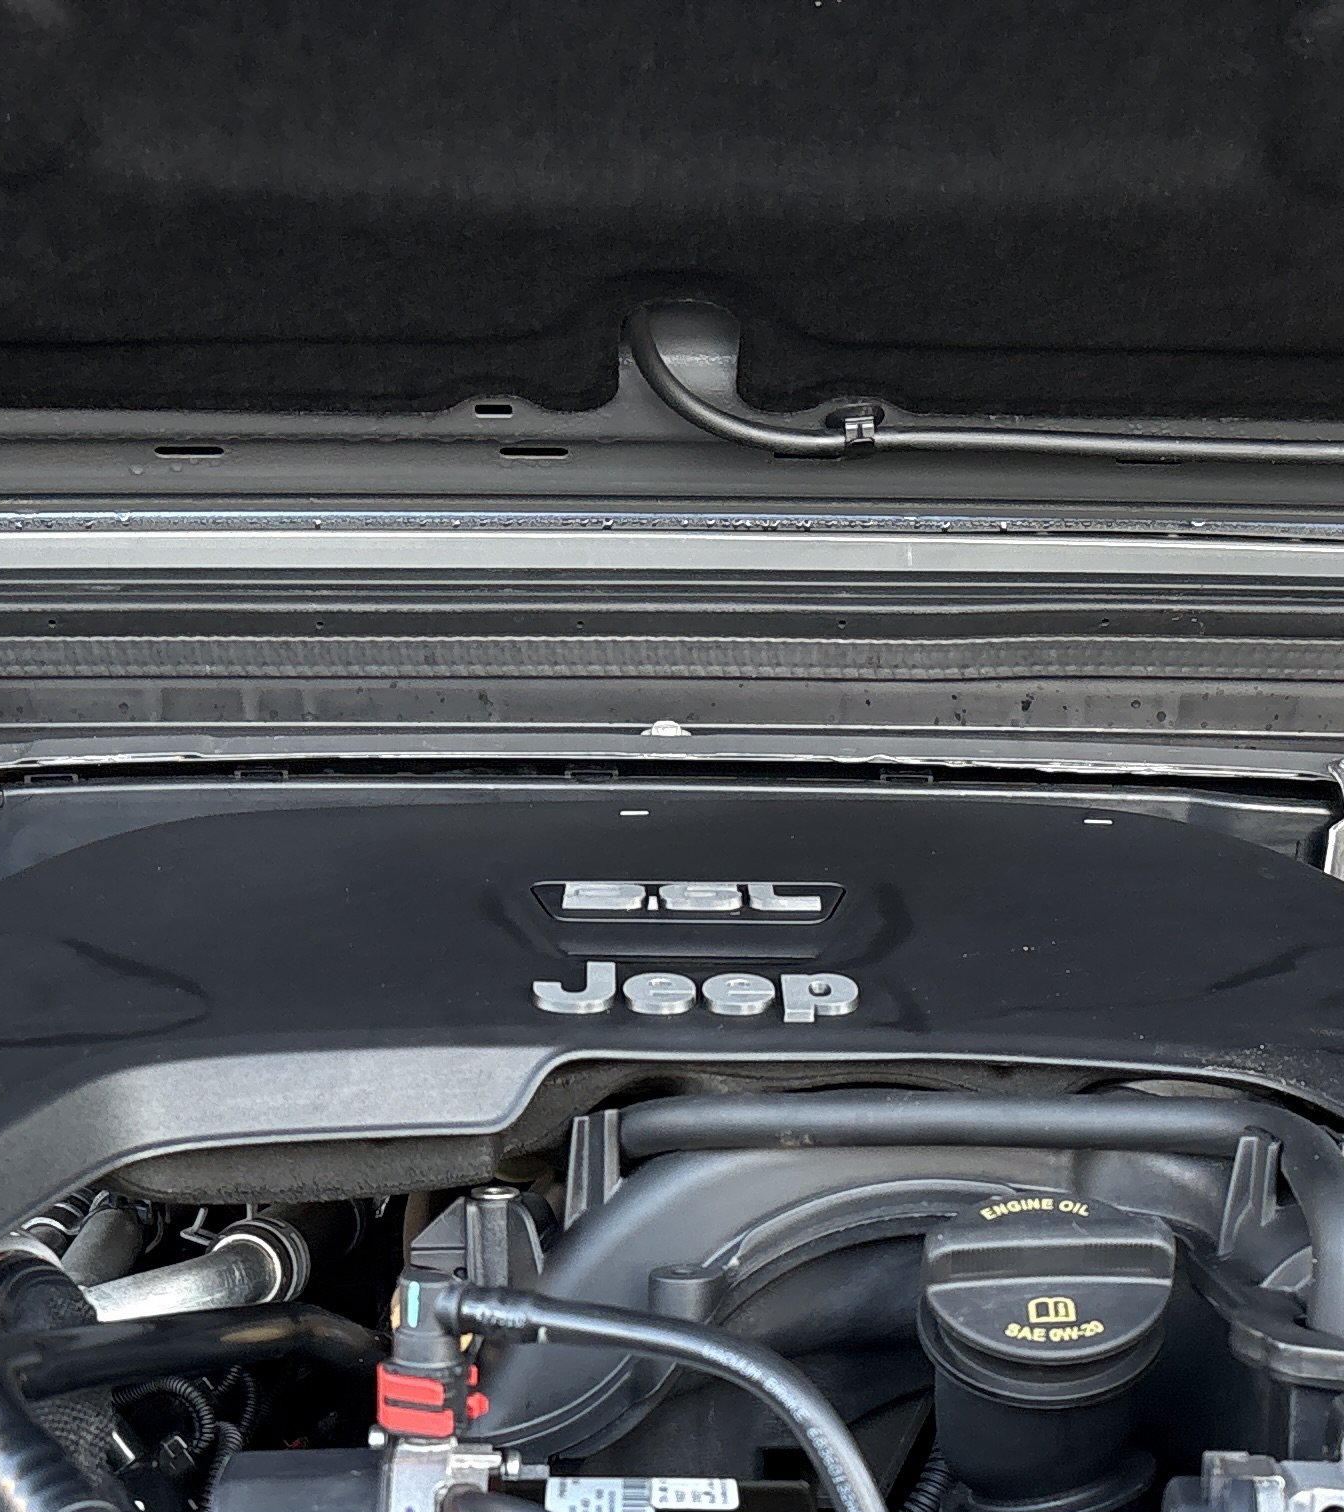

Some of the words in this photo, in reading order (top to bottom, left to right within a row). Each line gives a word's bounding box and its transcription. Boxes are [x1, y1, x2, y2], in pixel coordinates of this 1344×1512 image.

[532, 961, 858, 1023] Jeep
[979, 1198, 1054, 1221] ENGINE
[1058, 1200, 1090, 1217] OIL
[1004, 1323, 1046, 1342] SAE
[1048, 1320, 1105, 1342] 0W-20
